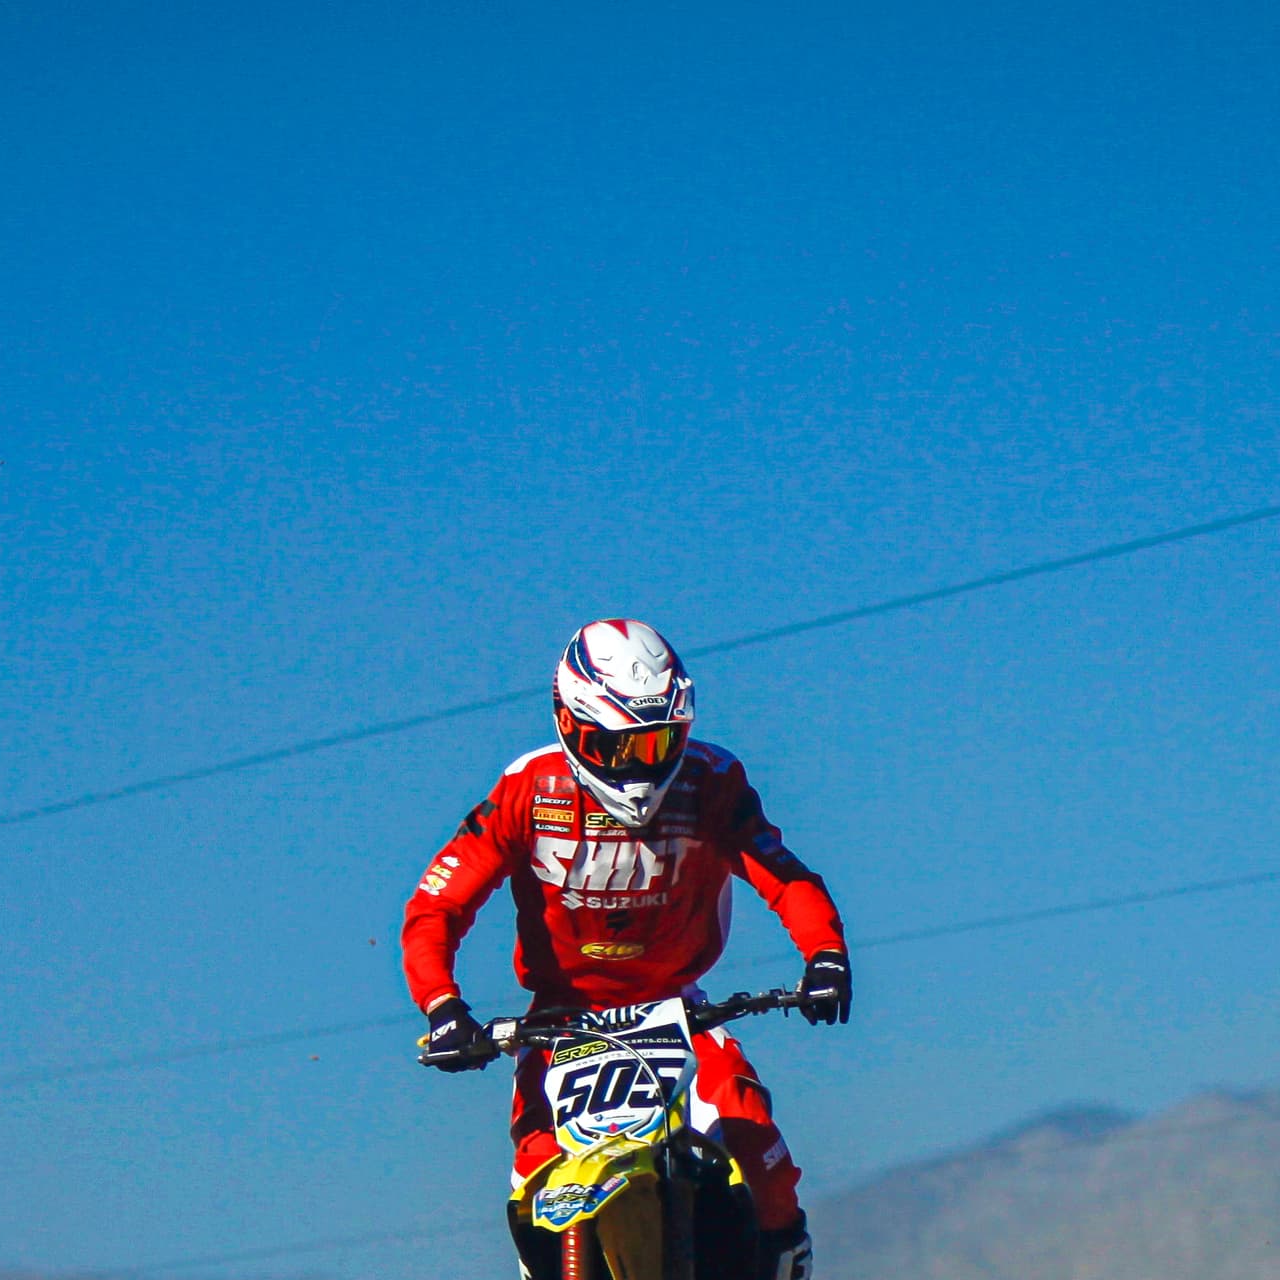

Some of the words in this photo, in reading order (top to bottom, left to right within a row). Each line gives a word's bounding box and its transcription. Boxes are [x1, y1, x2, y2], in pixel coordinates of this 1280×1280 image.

[632, 697, 665, 707] SHOEI
[531, 836, 703, 891] SHIFT
[586, 893, 668, 909] SUZUKI
[581, 1002, 657, 1030] MIK
[557, 1060, 678, 1127] 505
